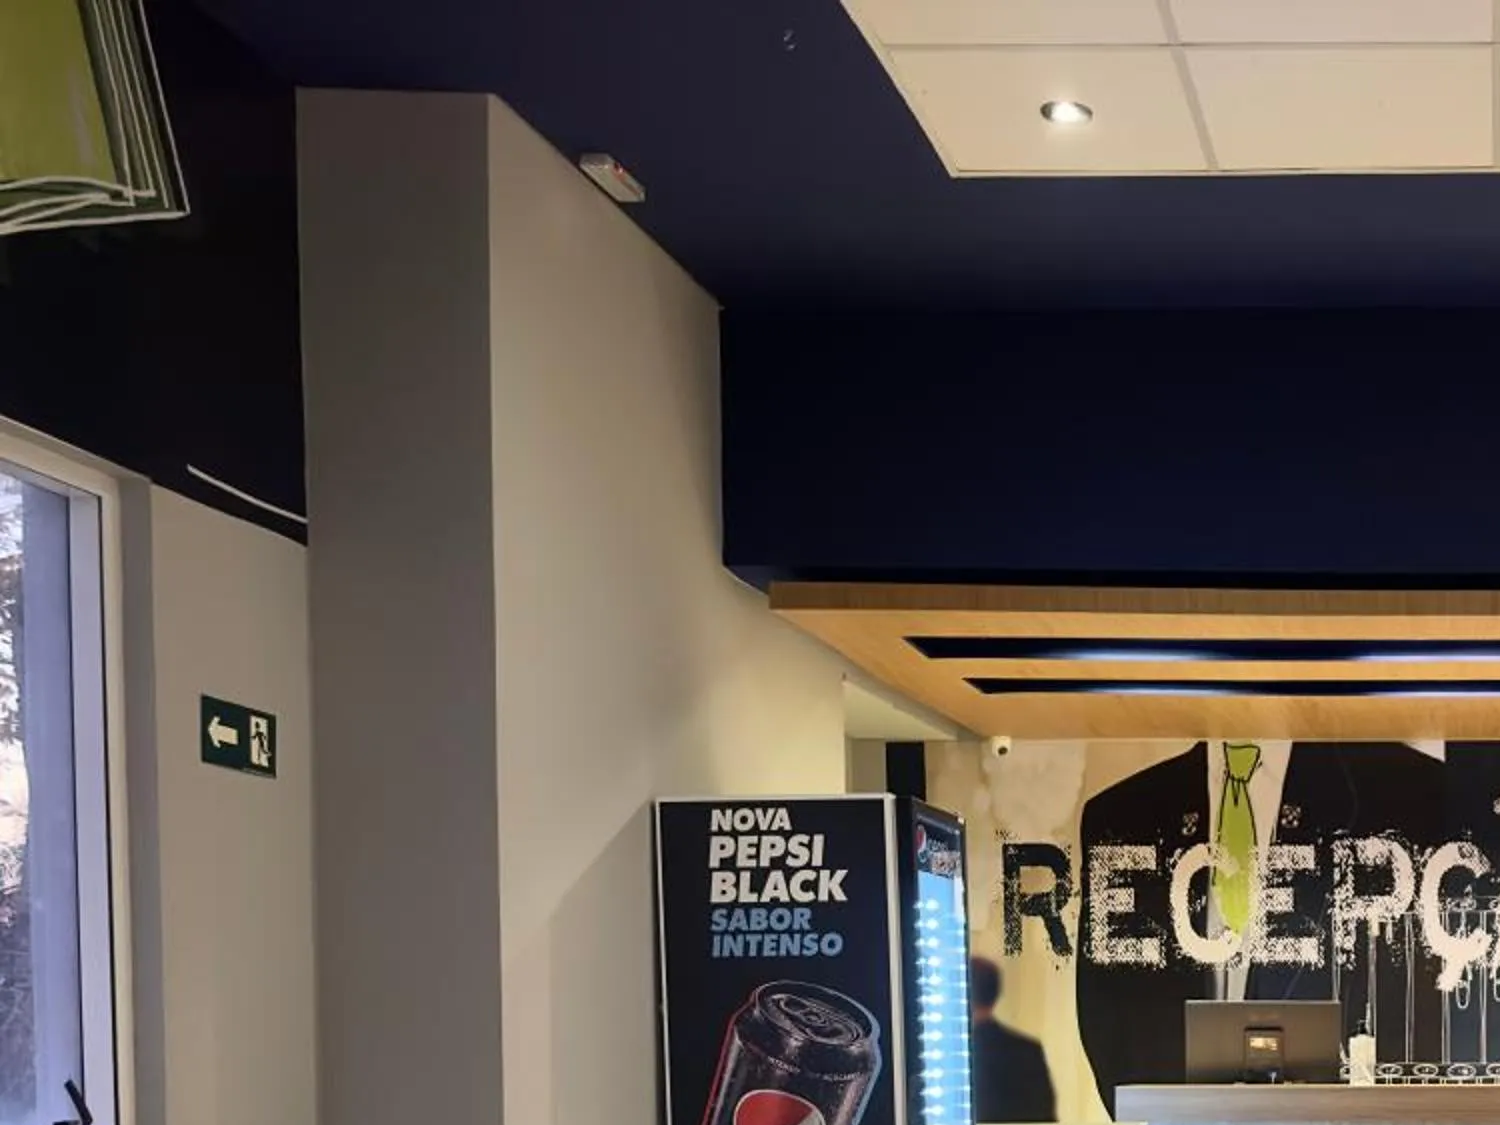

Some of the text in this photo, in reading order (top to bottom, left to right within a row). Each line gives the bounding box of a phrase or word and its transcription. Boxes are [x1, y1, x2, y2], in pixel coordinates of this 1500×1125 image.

[711, 808, 792, 831] NOVA
[709, 834, 825, 868] PEPSI
[710, 870, 848, 903] BLACK
[711, 908, 811, 931] SABOR
[712, 934, 844, 957] INTENSO
